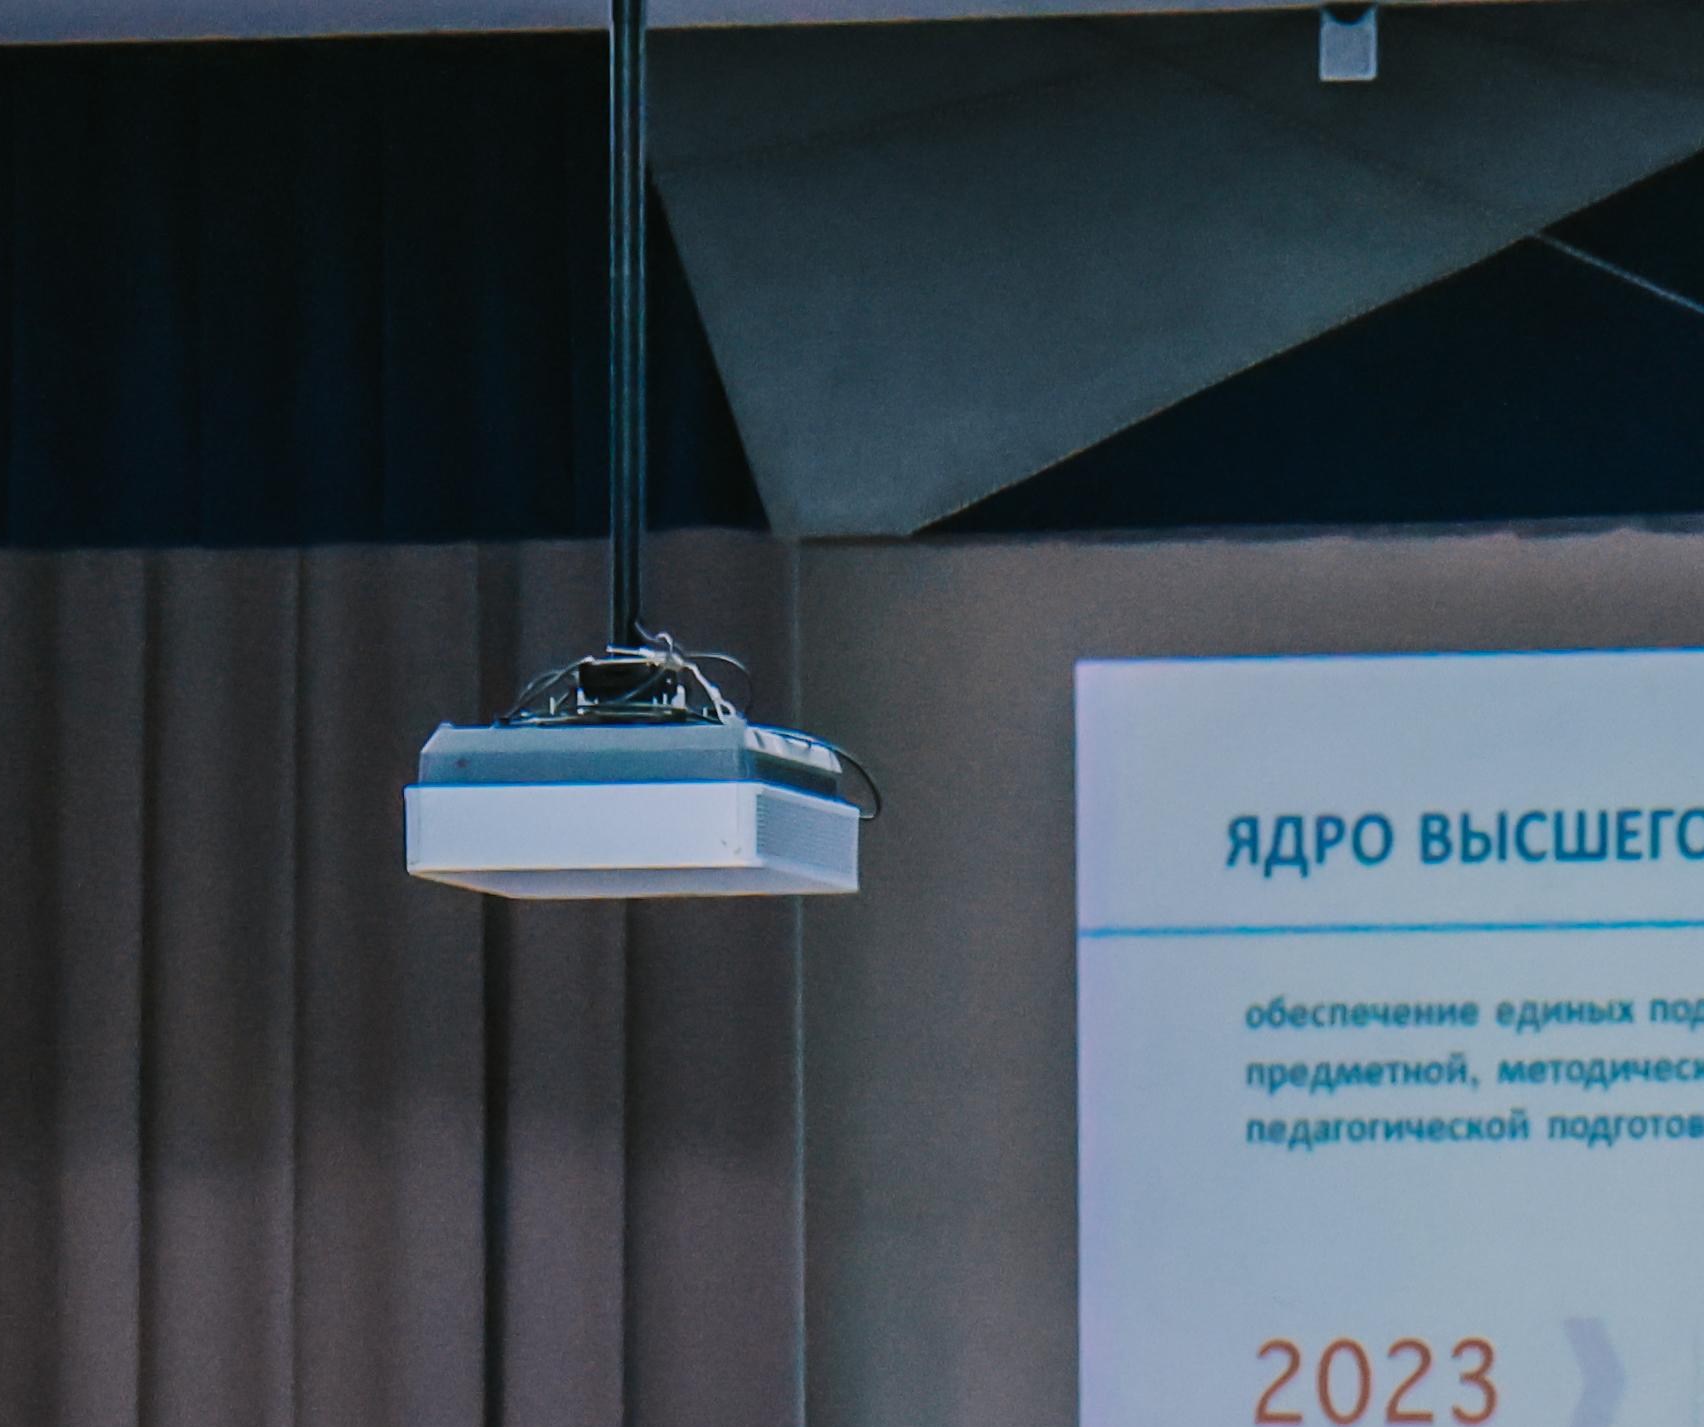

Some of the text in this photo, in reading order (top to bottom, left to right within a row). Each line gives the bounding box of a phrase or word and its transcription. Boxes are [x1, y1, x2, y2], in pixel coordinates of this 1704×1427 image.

[1225, 812, 1395, 880] ЯДРО
[1244, 996, 1480, 1031] обеспечение
[1495, 1000, 1635, 1035] единых
[1246, 1053, 1479, 1096] предметной,
[1245, 1108, 1532, 1153] педагогической
[1254, 1336, 1498, 1427] 2023
